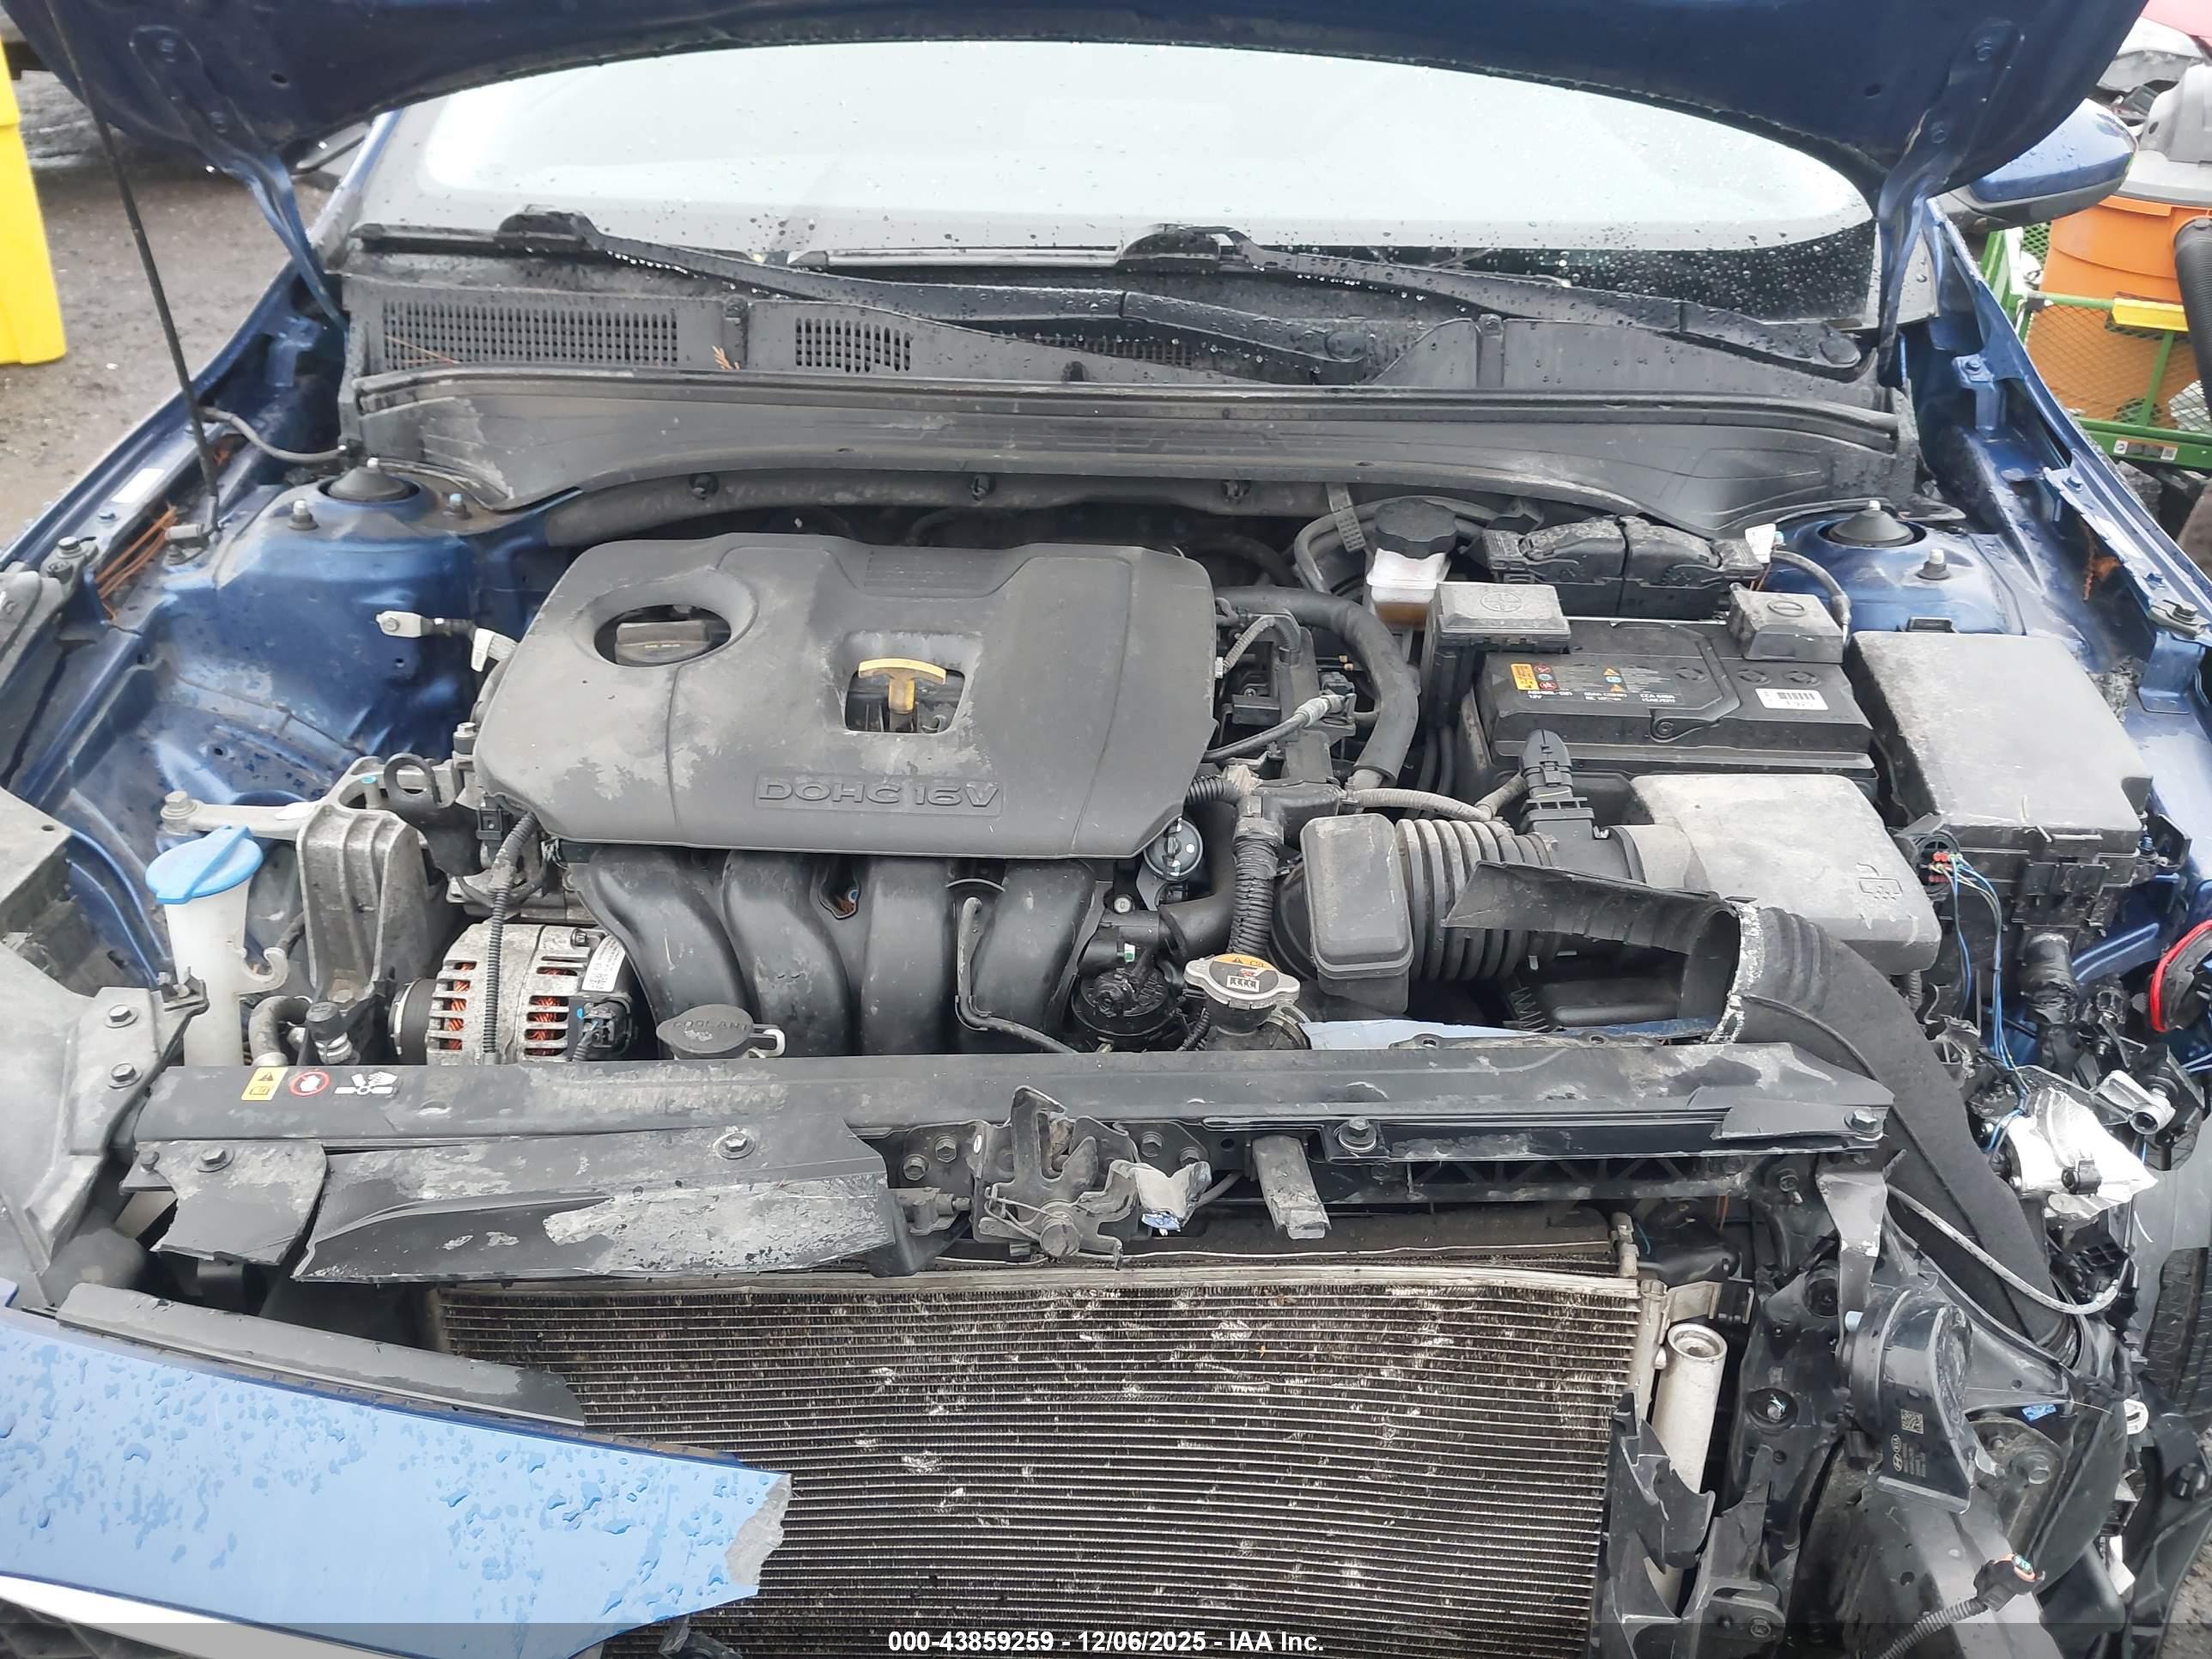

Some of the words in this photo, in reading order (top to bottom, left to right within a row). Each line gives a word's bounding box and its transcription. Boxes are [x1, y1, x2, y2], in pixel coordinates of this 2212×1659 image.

[758, 781, 902, 805] DOHC
[915, 782, 1000, 808] 16V
[672, 1019, 750, 1031] COOLANT
